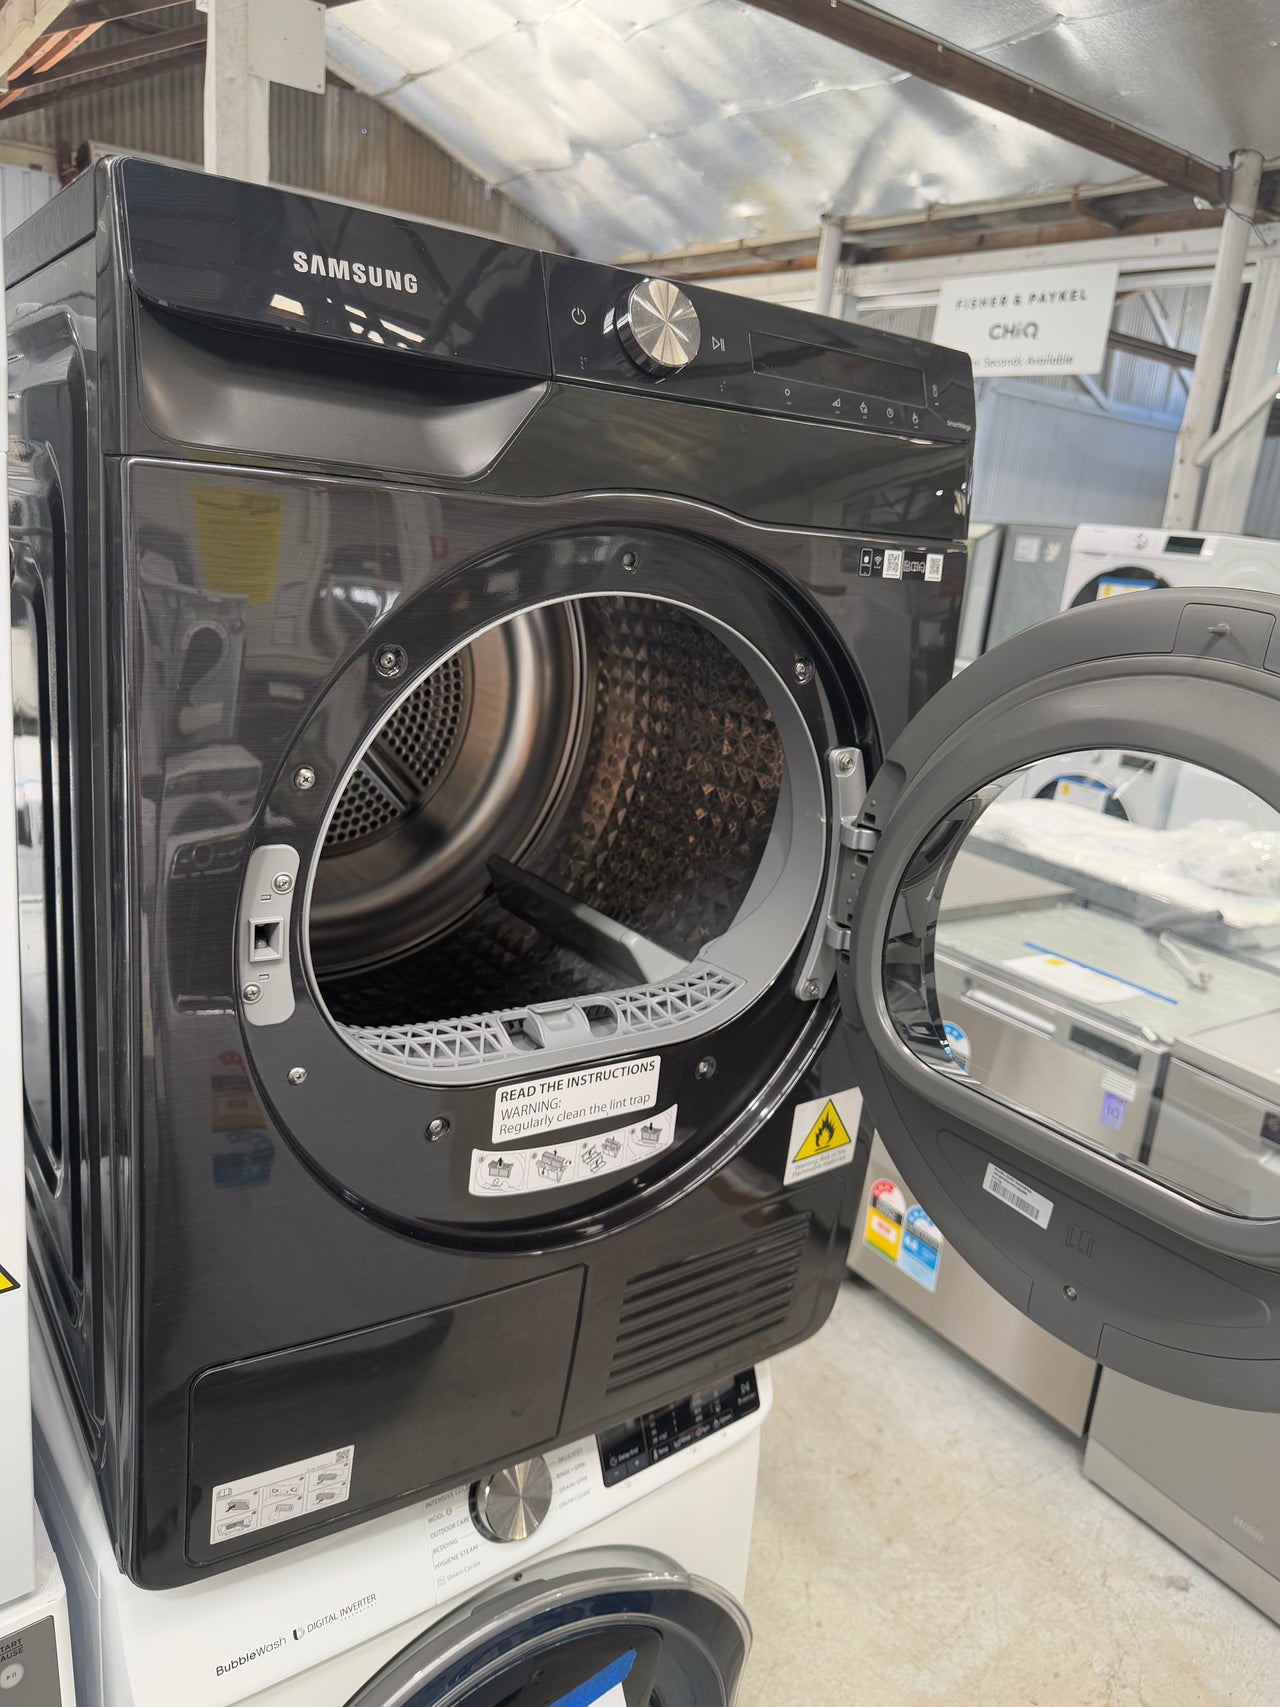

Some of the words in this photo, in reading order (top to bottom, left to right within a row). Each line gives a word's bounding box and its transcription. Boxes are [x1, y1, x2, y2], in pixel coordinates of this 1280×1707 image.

[292, 250, 418, 294] SAMSUNG
[955, 296, 1009, 311] FISHER
[1013, 295, 1023, 306] &
[1029, 288, 1088, 305] PAYKEL
[983, 357, 1024, 369] Seconds
[1024, 353, 1074, 366] Available
[500, 1085, 536, 1103] READ
[539, 1079, 564, 1094] THE
[566, 1060, 656, 1089] INSTRUCTIONS
[499, 1113, 554, 1136] Regularly
[556, 1107, 586, 1123] clean
[589, 1102, 607, 1116] the
[609, 1098, 627, 1111] lint
[629, 1093, 651, 1106] trap
[500, 1097, 562, 1121] WARNING:
[557, 1447, 584, 1464] DELICATES
[425, 1490, 454, 1509] INTENSIVE
[427, 1513, 445, 1524] WOOL
[430, 1523, 456, 1539] OUTDOOR
[456, 1516, 470, 1528] CARE
[432, 1538, 458, 1554] BEDDING
[433, 1553, 460, 1570] HYGIENE
[460, 1544, 479, 1559] STEAM
[445, 1568, 463, 1582] Steam
[306, 1612, 339, 1633] DIGITAL
[339, 1593, 377, 1618] INVERTER
[0, 1638, 23, 1653] TART
[0, 1646, 24, 1662] AUSE
[215, 1635, 287, 1677] BubbleWash
